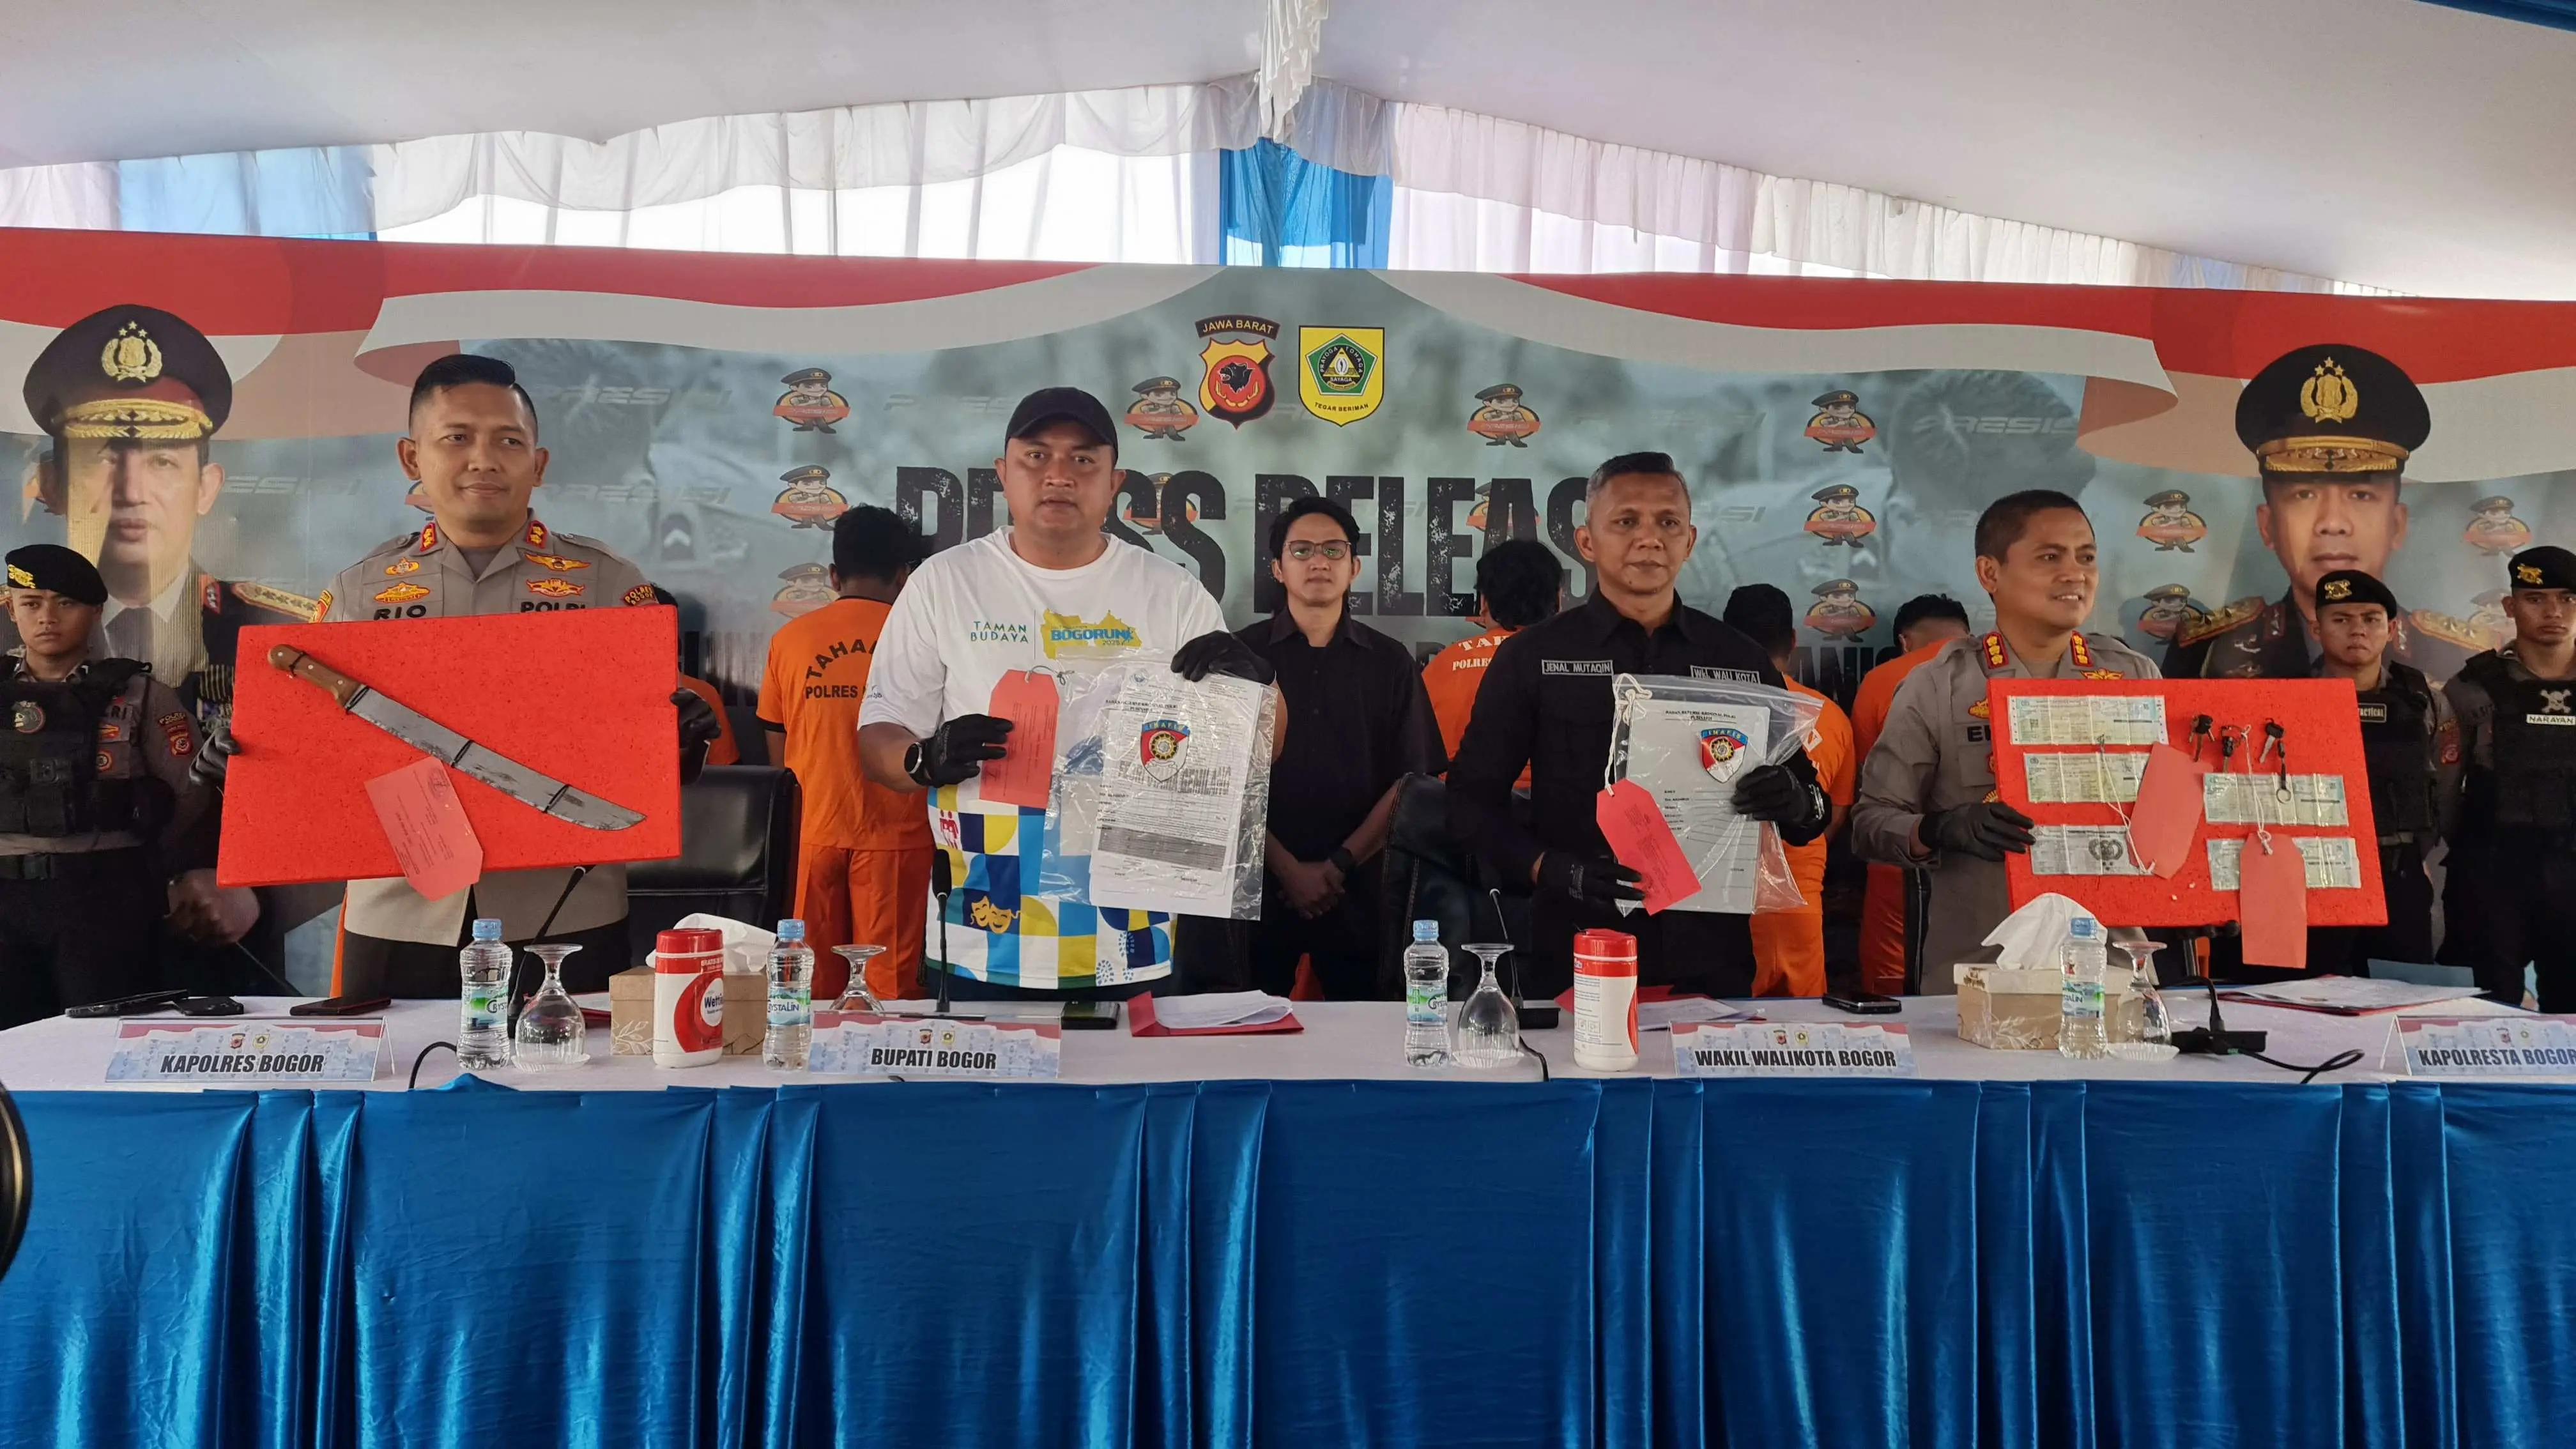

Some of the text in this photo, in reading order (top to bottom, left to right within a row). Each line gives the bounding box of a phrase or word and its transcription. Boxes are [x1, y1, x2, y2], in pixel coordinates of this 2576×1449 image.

[1203, 319, 1275, 334] JAWA BARAT
[1319, 346, 1338, 373] PRAYOGA
[1315, 402, 1368, 412] TEGAR BERIMAN
[373, 604, 427, 620] RIO
[974, 621, 1027, 632] TAMAN
[970, 631, 1029, 644] BUDAYA
[1545, 661, 1612, 673] JENAL MUTAQIN
[805, 684, 858, 699] POLRES
[160, 1055, 325, 1073] KAPOLRES BOGOR
[871, 1048, 997, 1070] BUPATI BOGOR
[1694, 1050, 1897, 1067] WAKIL WALIKOTA BOGOR
[2418, 1049, 2522, 1066] KAPOLRESTA
